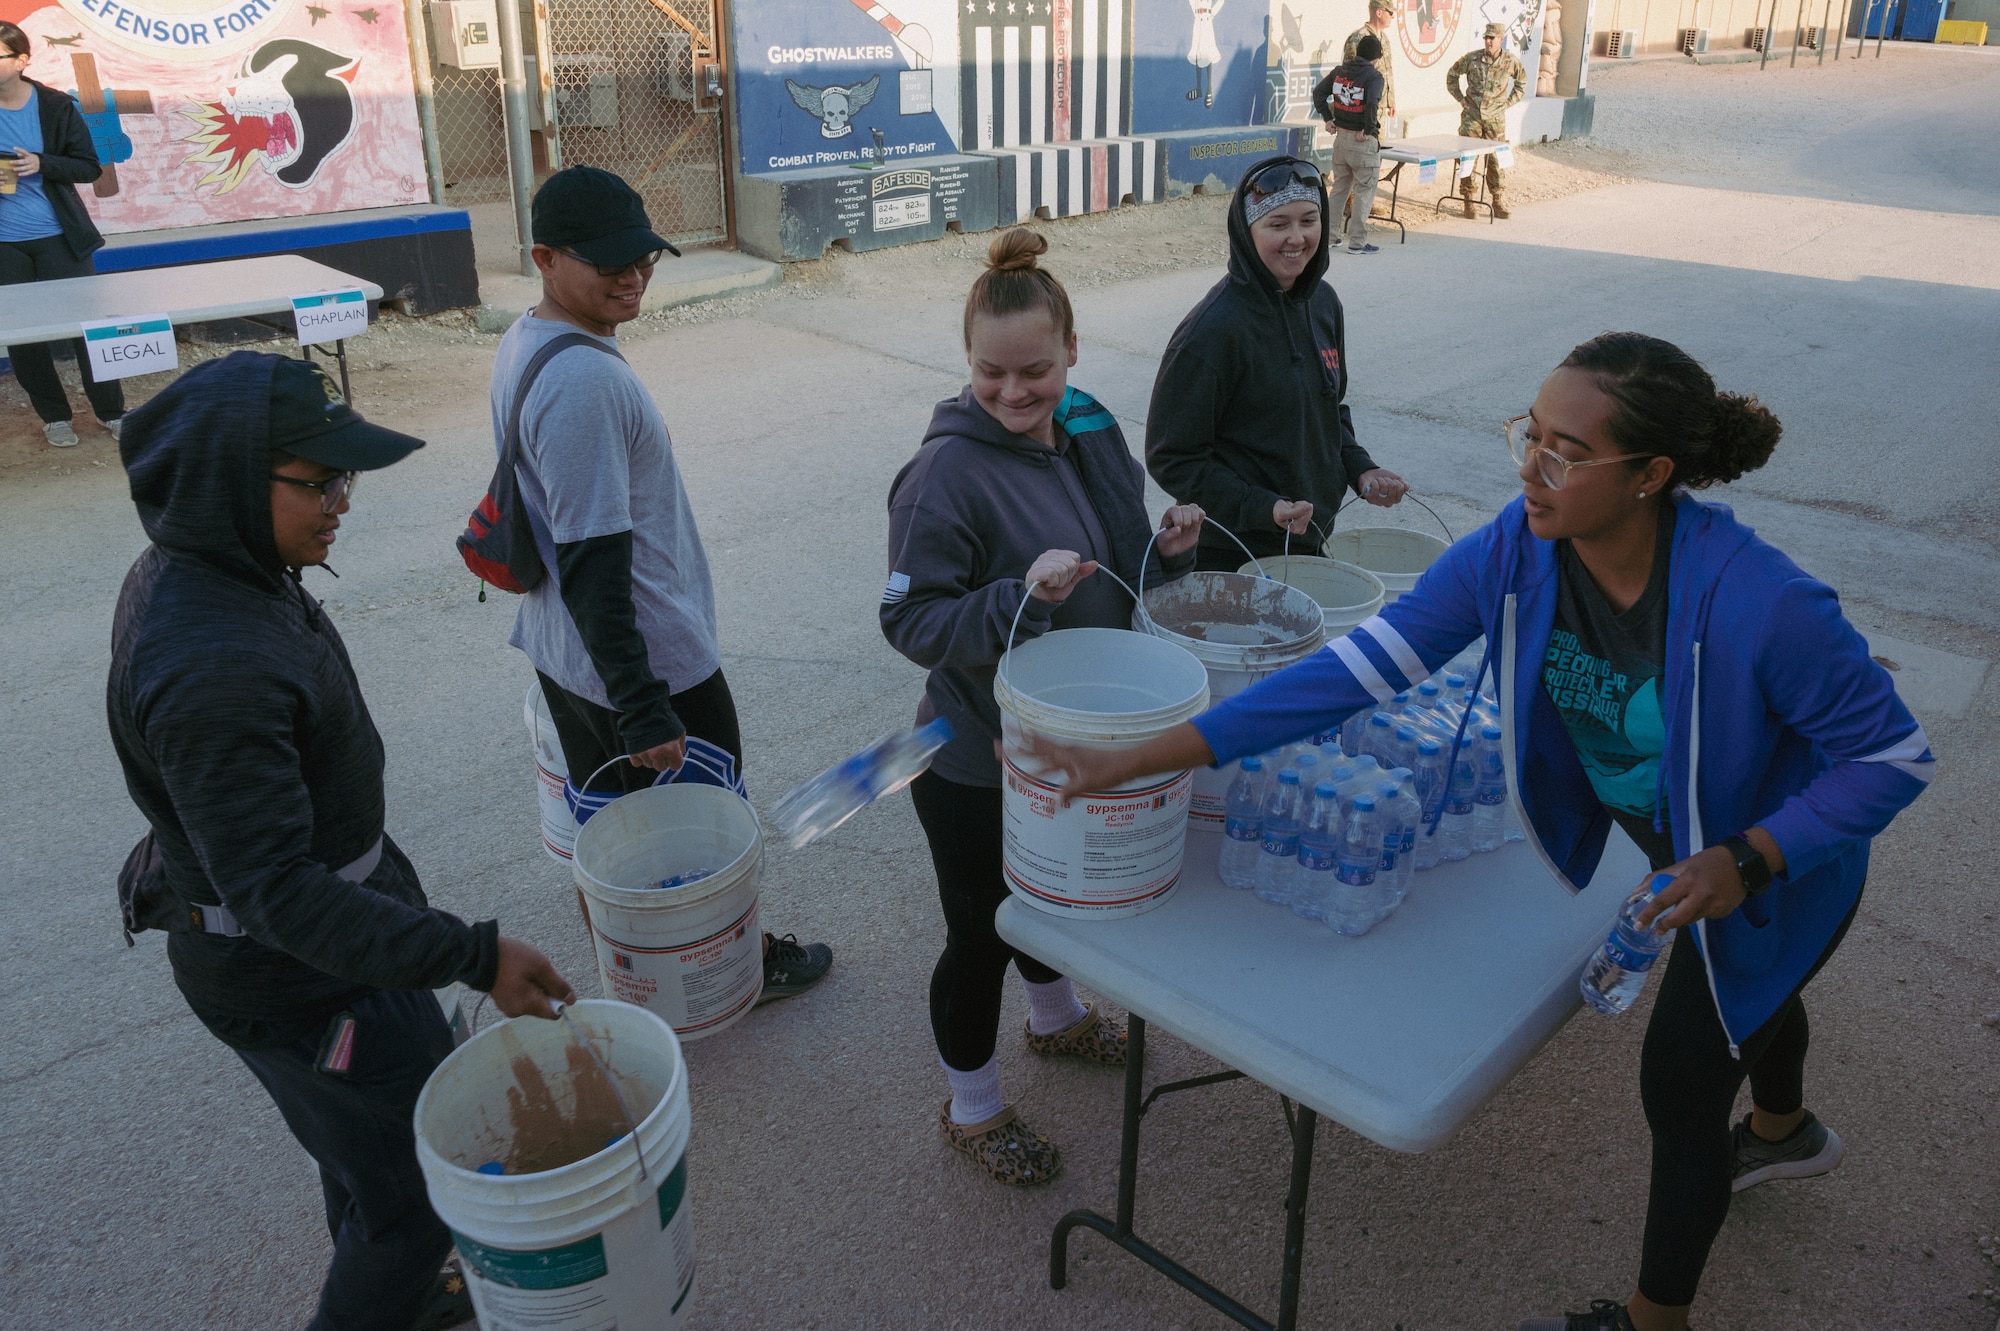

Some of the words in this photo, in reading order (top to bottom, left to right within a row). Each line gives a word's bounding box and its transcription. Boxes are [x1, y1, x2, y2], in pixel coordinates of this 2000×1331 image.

[767, 45, 894, 65] GHOSTWALKERS
[1055, 30, 1066, 109] PROTECTION
[768, 153, 813, 168] COMBAT
[815, 149, 859, 164] PROVEN,
[861, 145, 893, 159] REDY
[895, 145, 907, 154] TO
[909, 142, 936, 153] FIGHT
[1190, 144, 1238, 160] INSPECTOR
[1240, 137, 1278, 153] GENERAL
[874, 173, 929, 192] SAFESIDE
[299, 308, 366, 328] CHAPLAIN
[102, 341, 166, 364] LEGAL
[1017, 783, 1071, 809] gypsema
[1030, 801, 1056, 815] JC-100
[1086, 802, 1150, 815] gypsemna
[1104, 813, 1135, 823] JC-100
[679, 936, 734, 963] gypsemna
[613, 985, 648, 1003] JC-100
